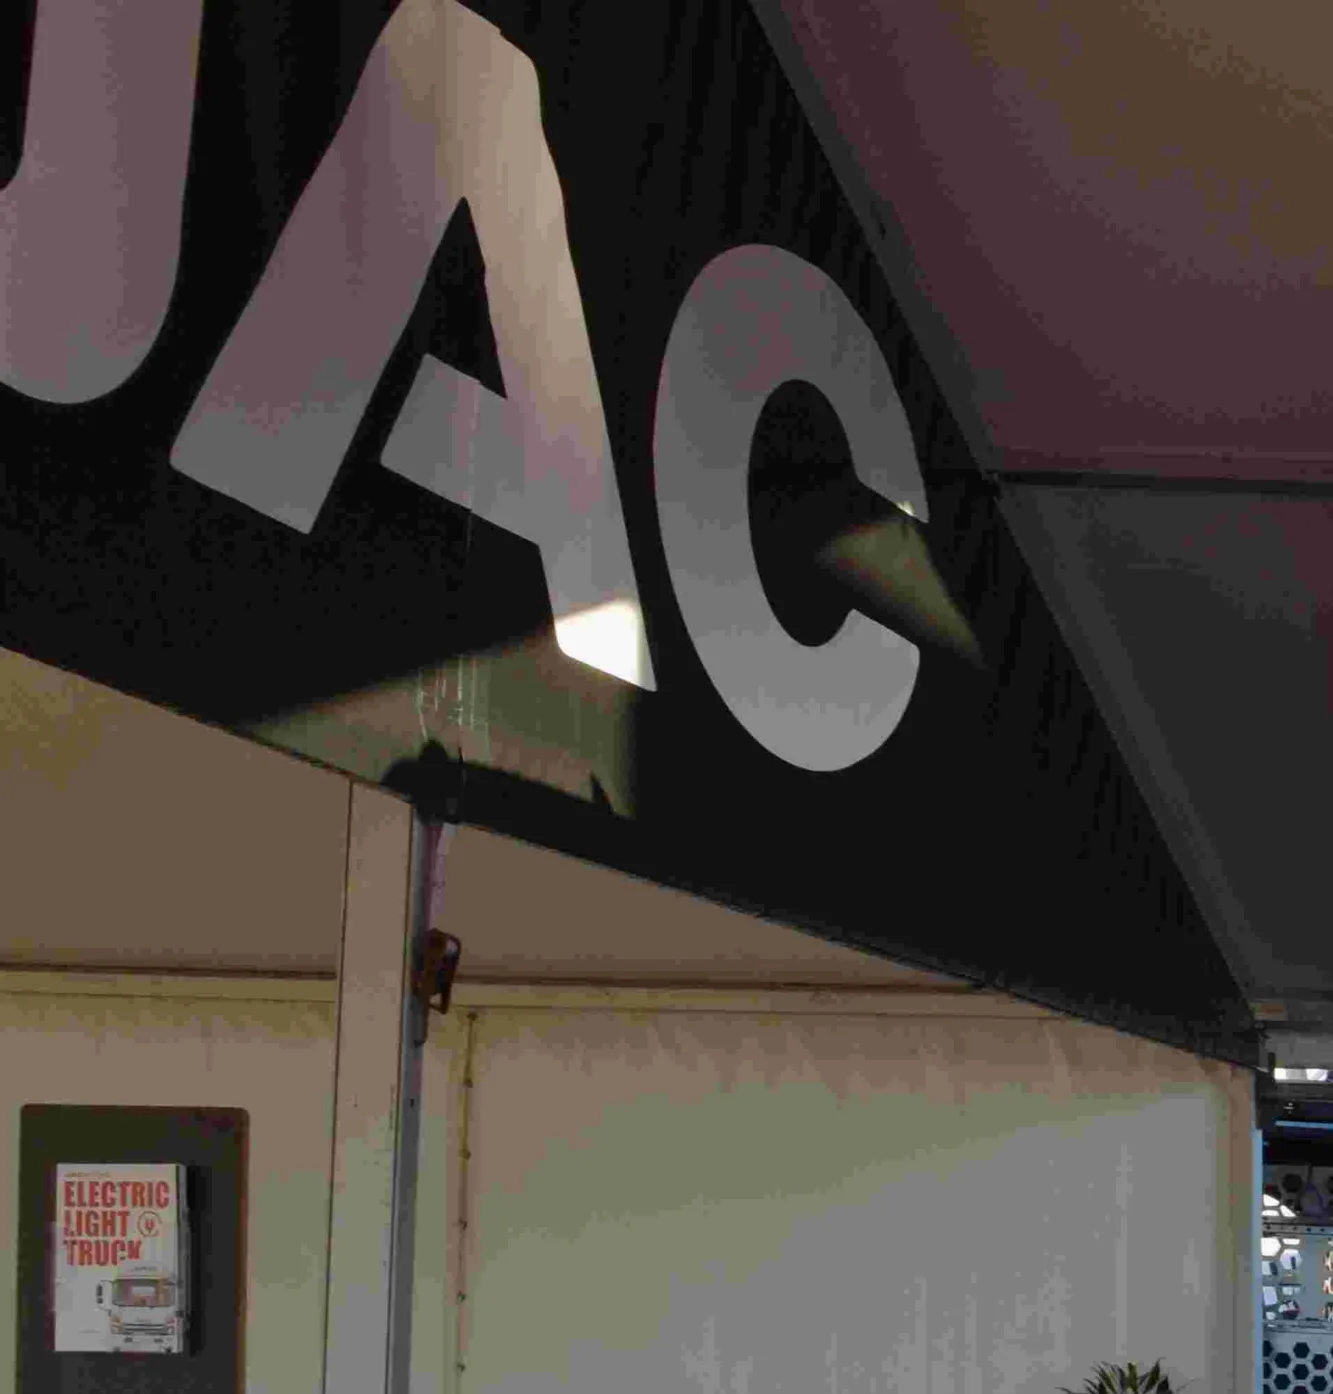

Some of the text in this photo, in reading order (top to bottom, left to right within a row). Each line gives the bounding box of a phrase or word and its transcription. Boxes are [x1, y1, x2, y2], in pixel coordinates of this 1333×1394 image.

[64, 1180, 170, 1208] ELECTRIC
[64, 1210, 130, 1237] LIGHT
[63, 1239, 143, 1266] TRUCK
